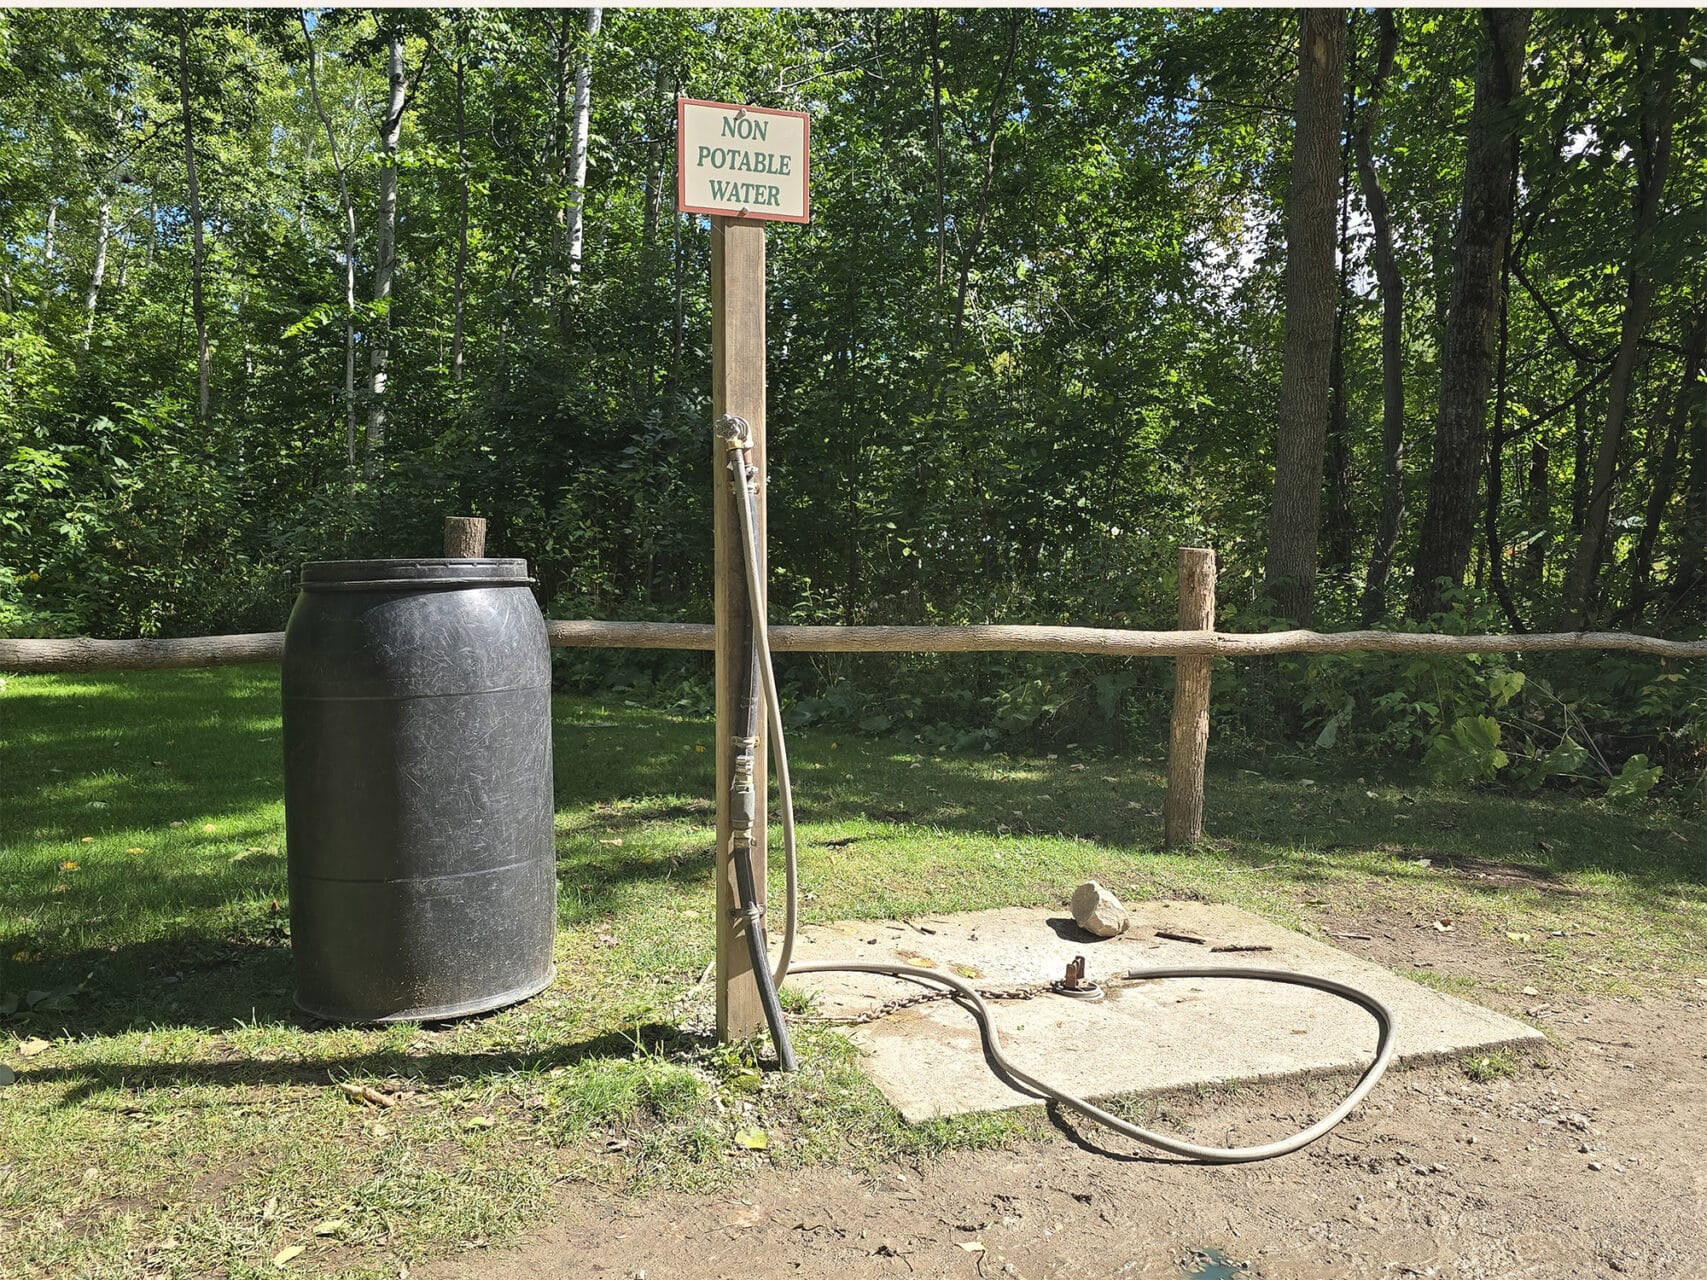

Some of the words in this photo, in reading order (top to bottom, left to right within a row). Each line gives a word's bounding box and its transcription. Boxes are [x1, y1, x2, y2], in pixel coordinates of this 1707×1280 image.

[721, 116, 768, 142] NON
[697, 146, 791, 176] POTABLE
[709, 180, 780, 206] WATER
